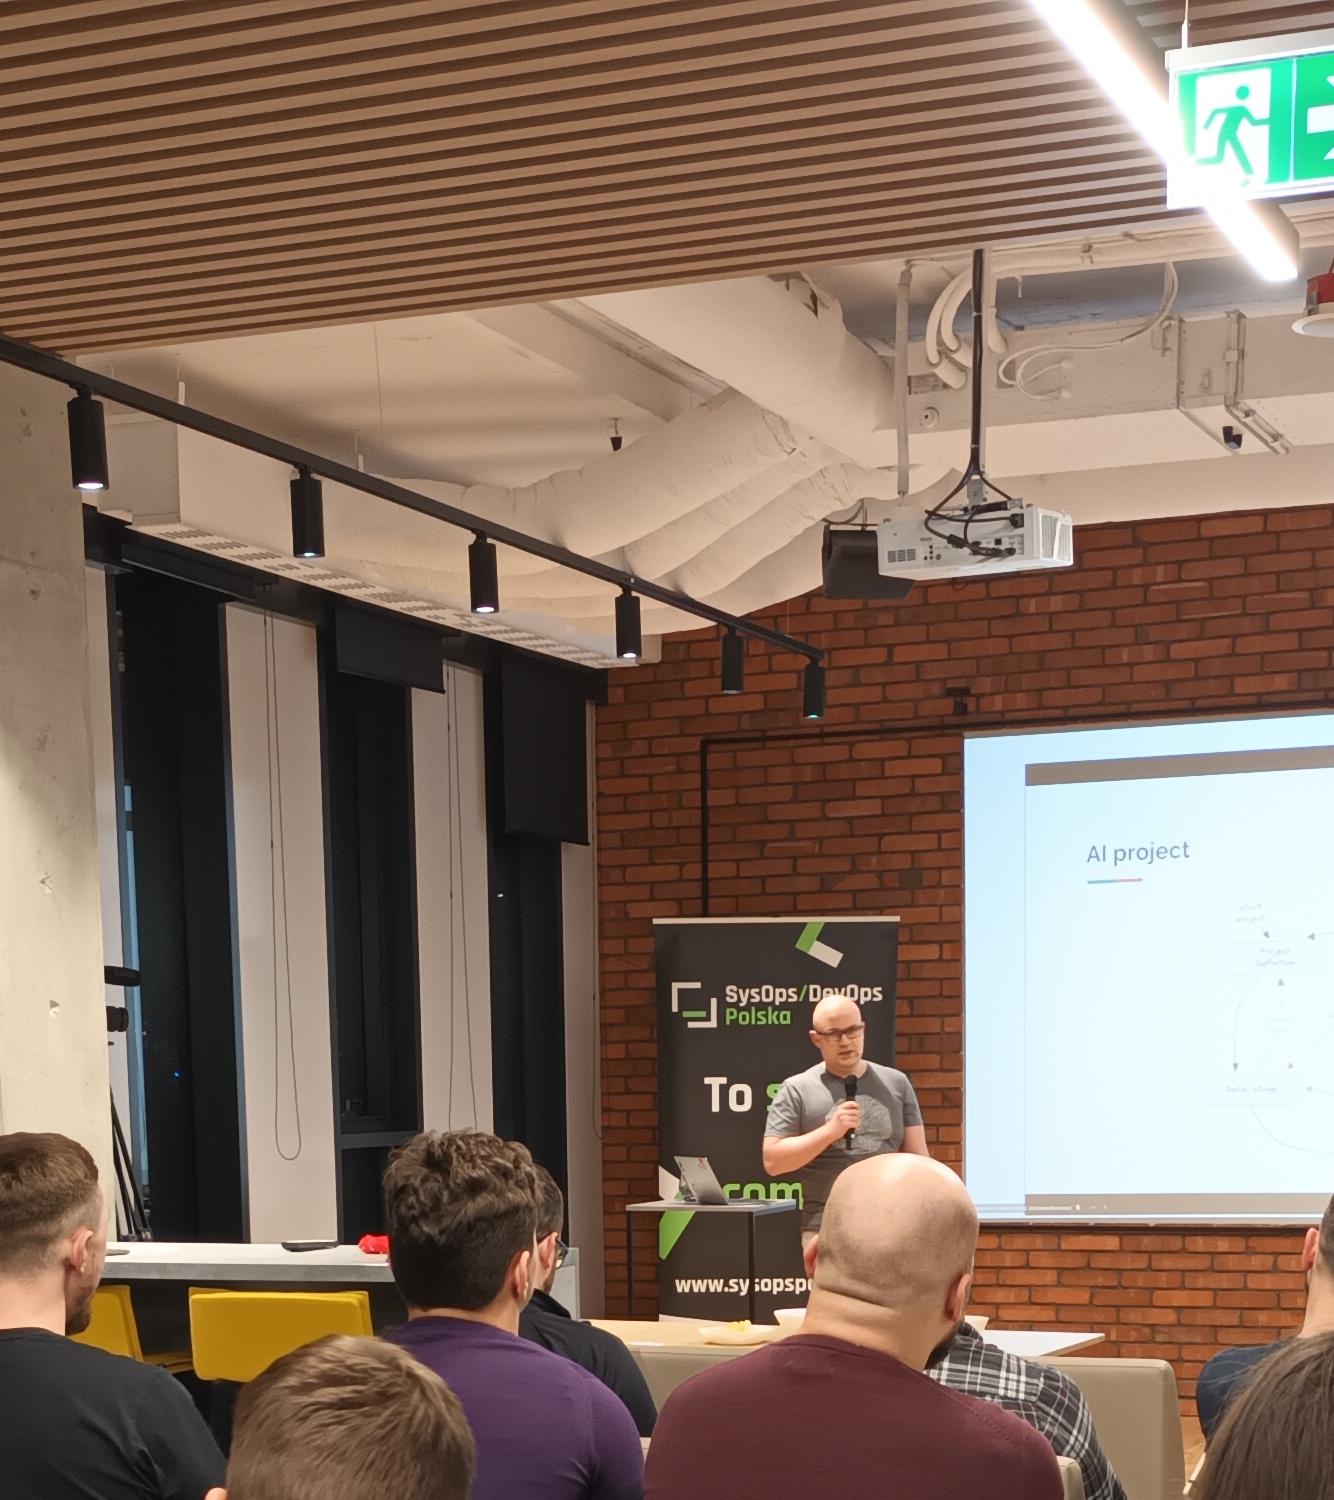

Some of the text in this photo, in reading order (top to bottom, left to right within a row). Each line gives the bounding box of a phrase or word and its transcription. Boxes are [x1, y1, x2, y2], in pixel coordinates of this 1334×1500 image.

[1086, 841, 1190, 867] AI project
[725, 983, 883, 1007] SysOps/DevOps
[725, 1006, 792, 1026] Polska
[703, 1076, 753, 1113] To
